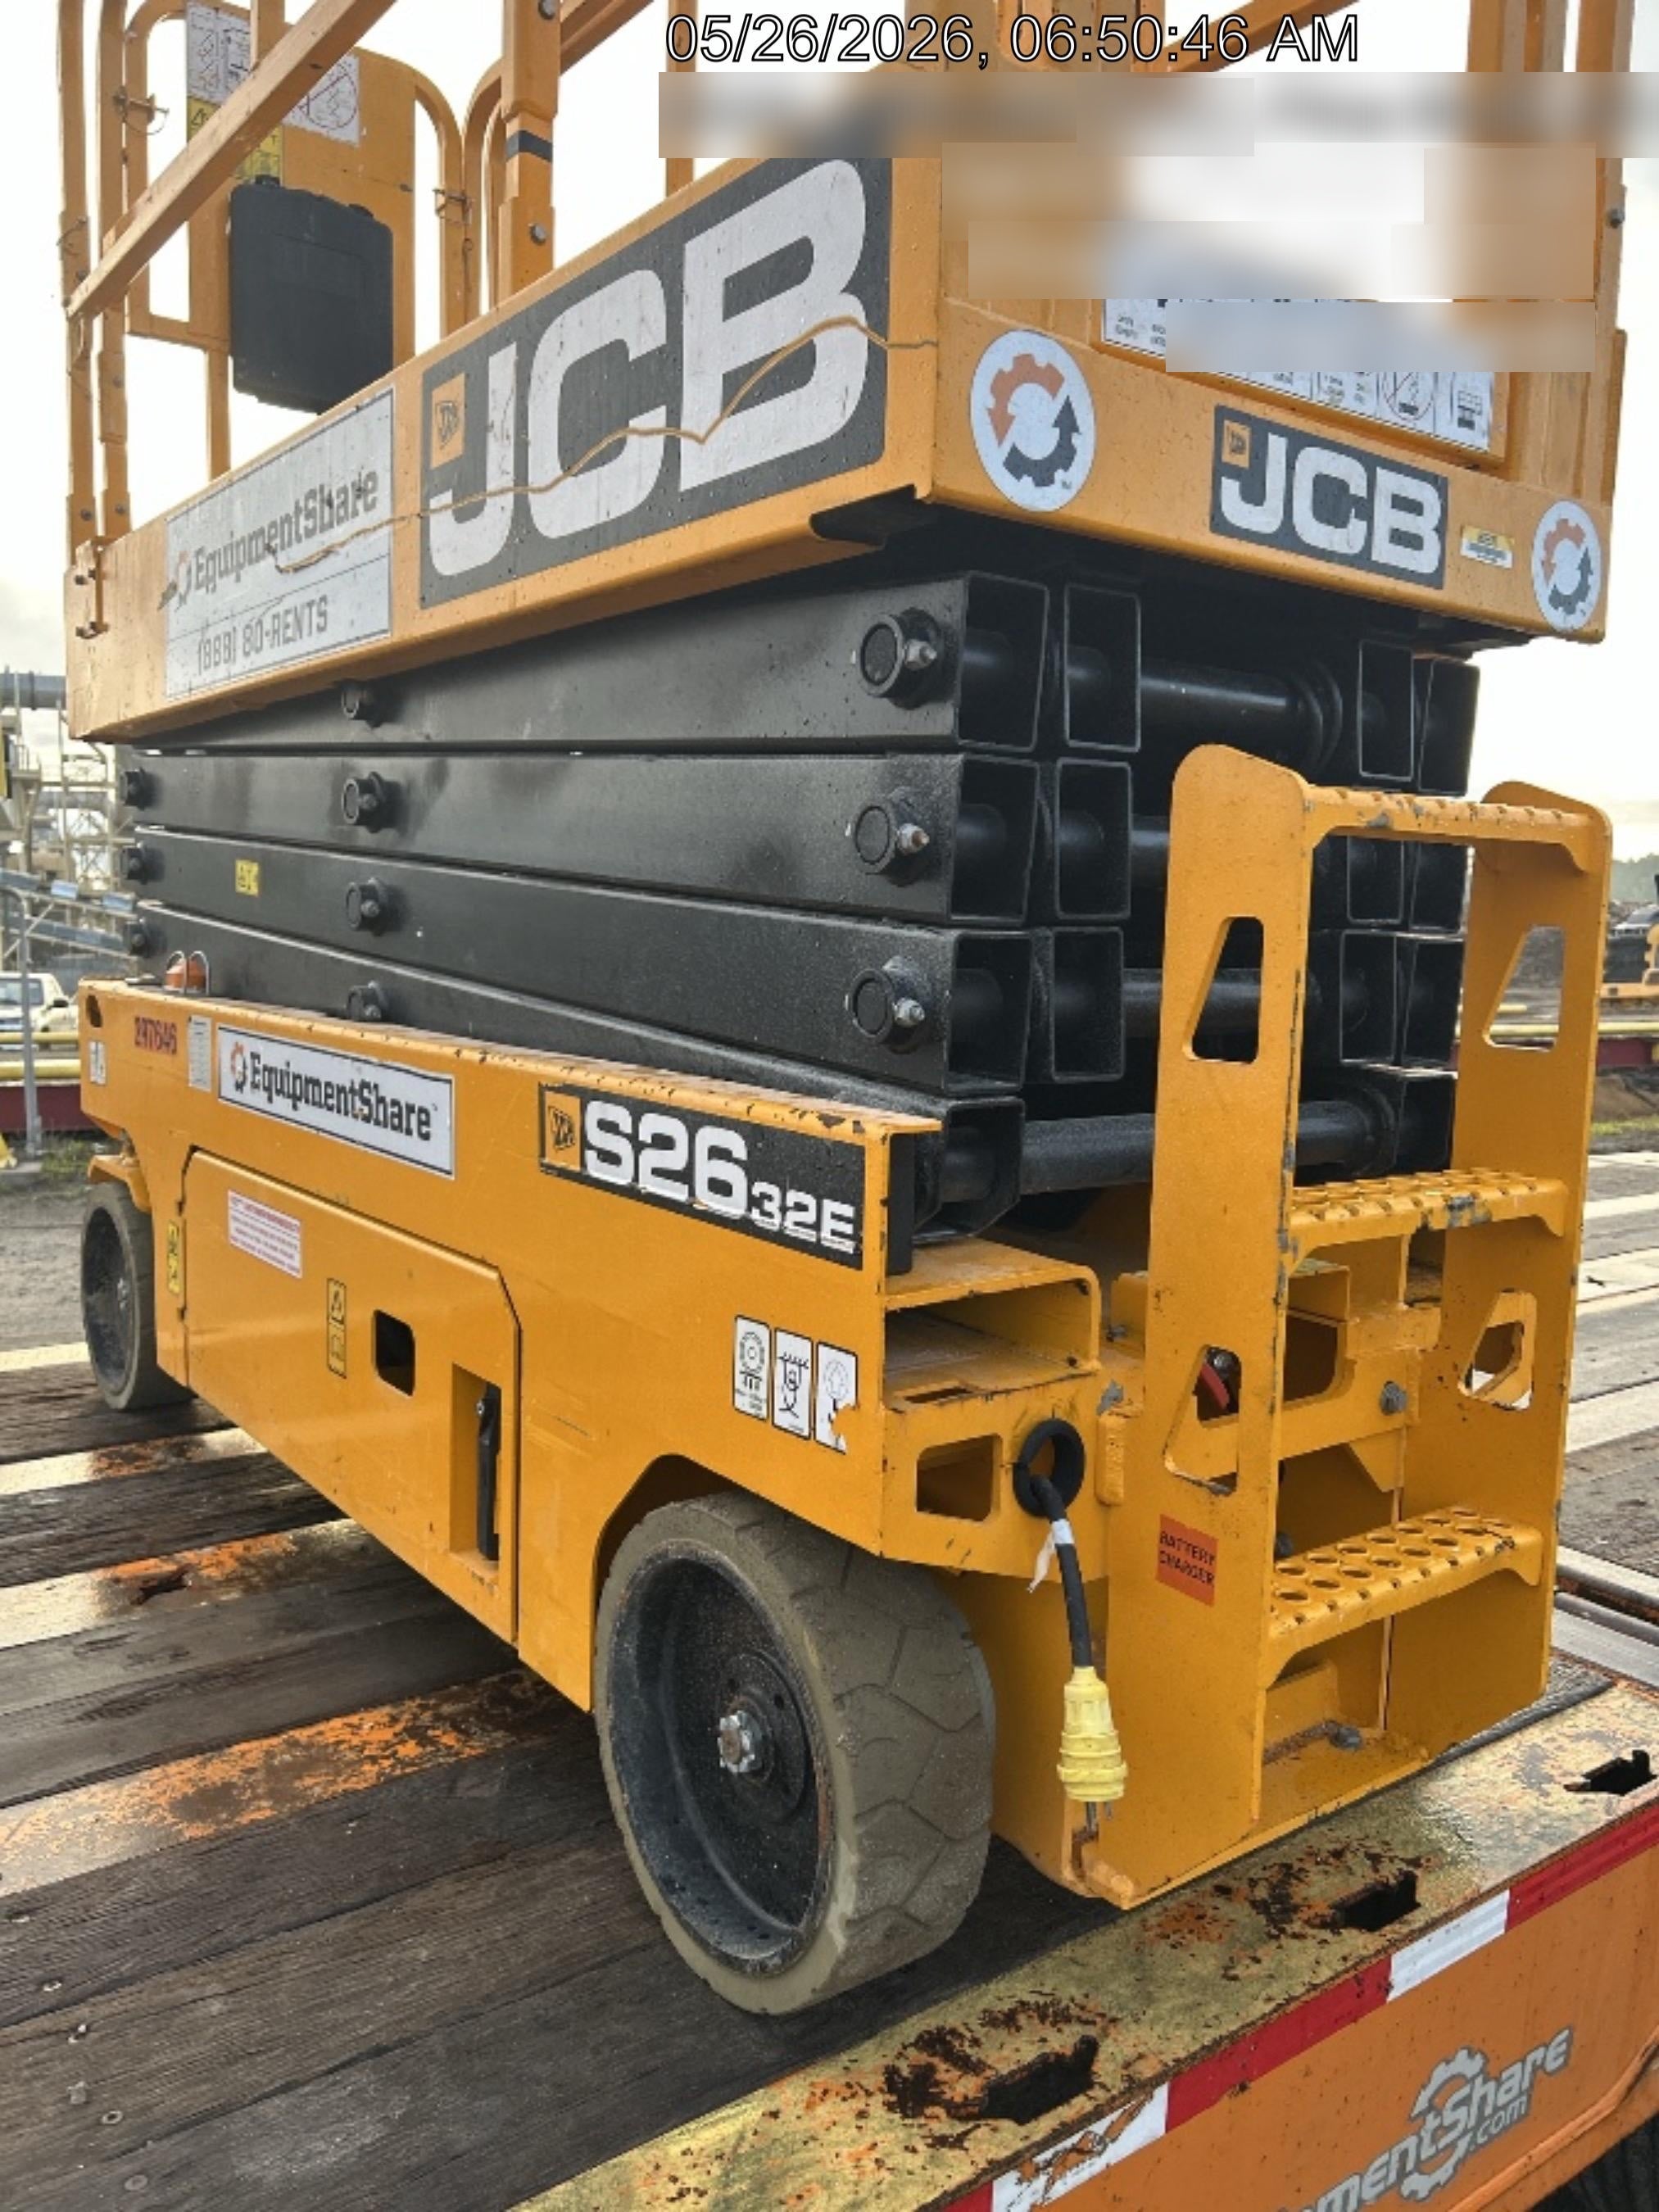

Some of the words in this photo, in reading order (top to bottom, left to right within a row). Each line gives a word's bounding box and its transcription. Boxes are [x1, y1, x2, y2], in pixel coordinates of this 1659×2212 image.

[429, 159, 868, 576] JCB
[194, 471, 378, 593] EquipmentShare
[1221, 432, 1442, 573] JCB
[250, 1051, 431, 1142] EquipmentShare
[1159, 1530, 1216, 1566] BATTERY
[1159, 1550, 1215, 1584] CHARGER
[1301, 2025, 1573, 2212] mentShare
[1470, 2094, 1529, 2151] .com
